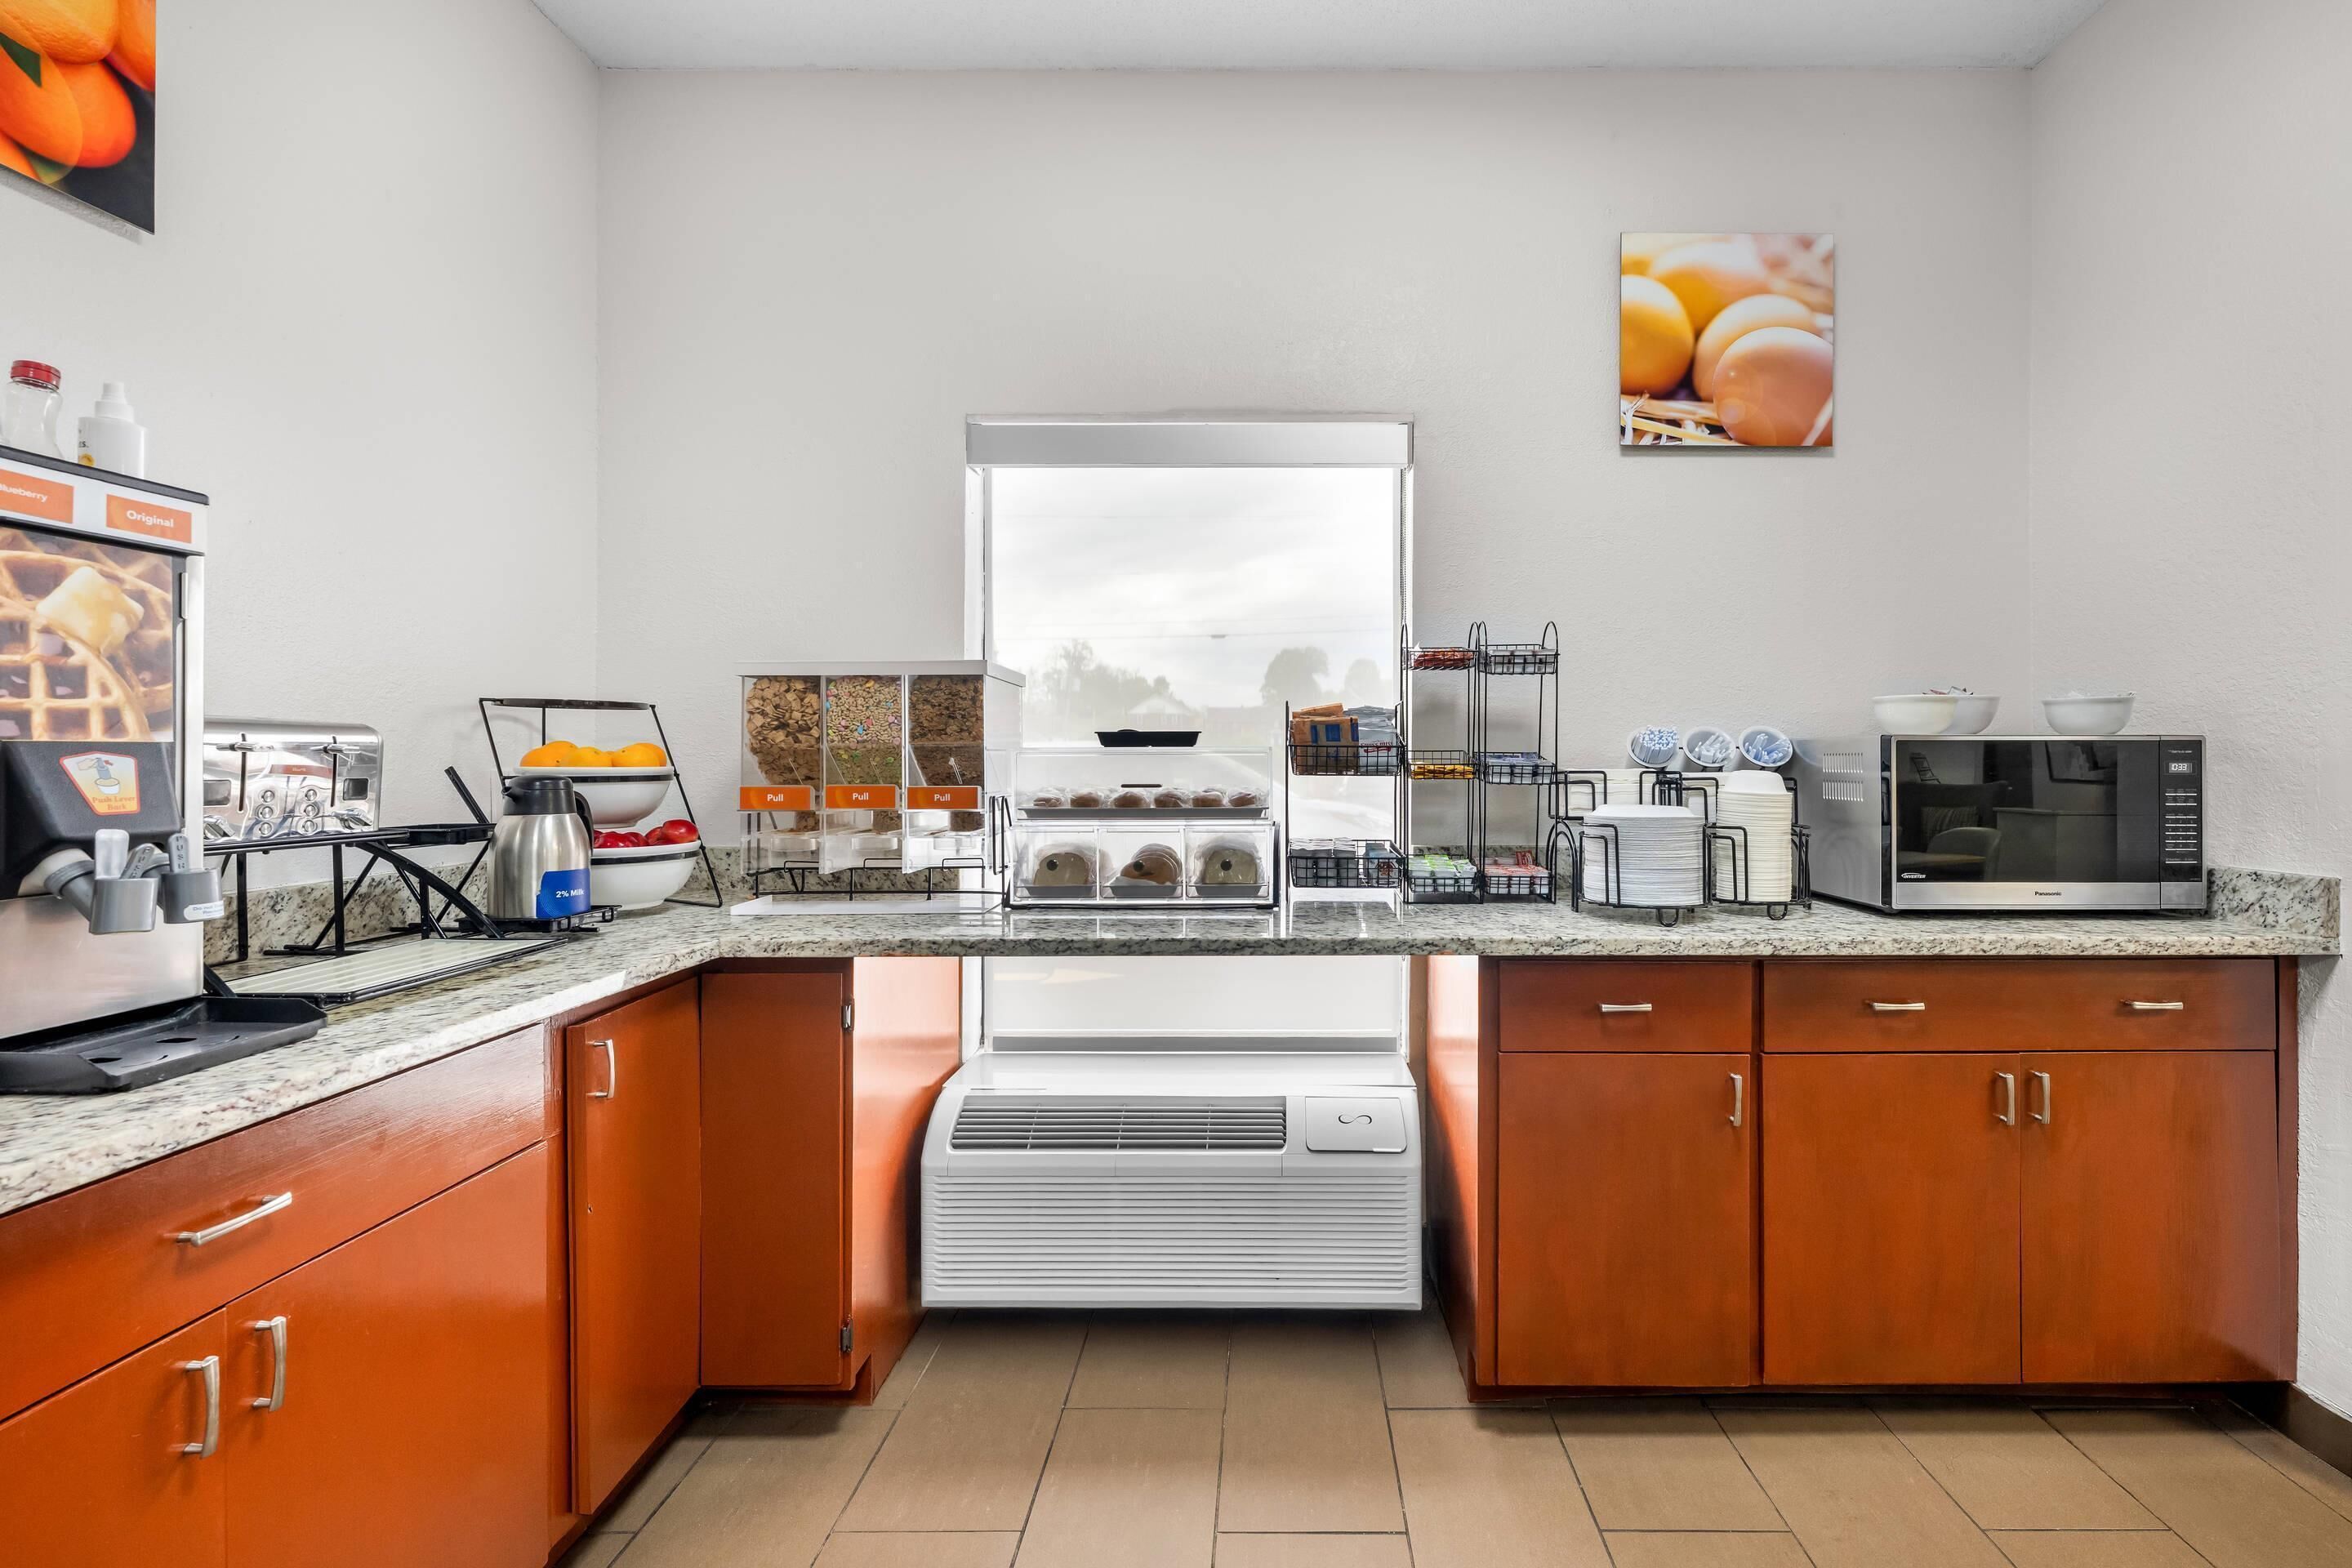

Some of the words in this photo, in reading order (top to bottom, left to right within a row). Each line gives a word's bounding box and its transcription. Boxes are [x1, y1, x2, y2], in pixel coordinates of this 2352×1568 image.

[126, 510, 174, 528] Original
[91, 795, 112, 804] Push
[767, 794, 784, 803] Pull
[852, 792, 869, 801] Pull
[933, 794, 951, 803] Pull
[555, 890, 569, 898] 2%
[570, 888, 585, 897] Milk
